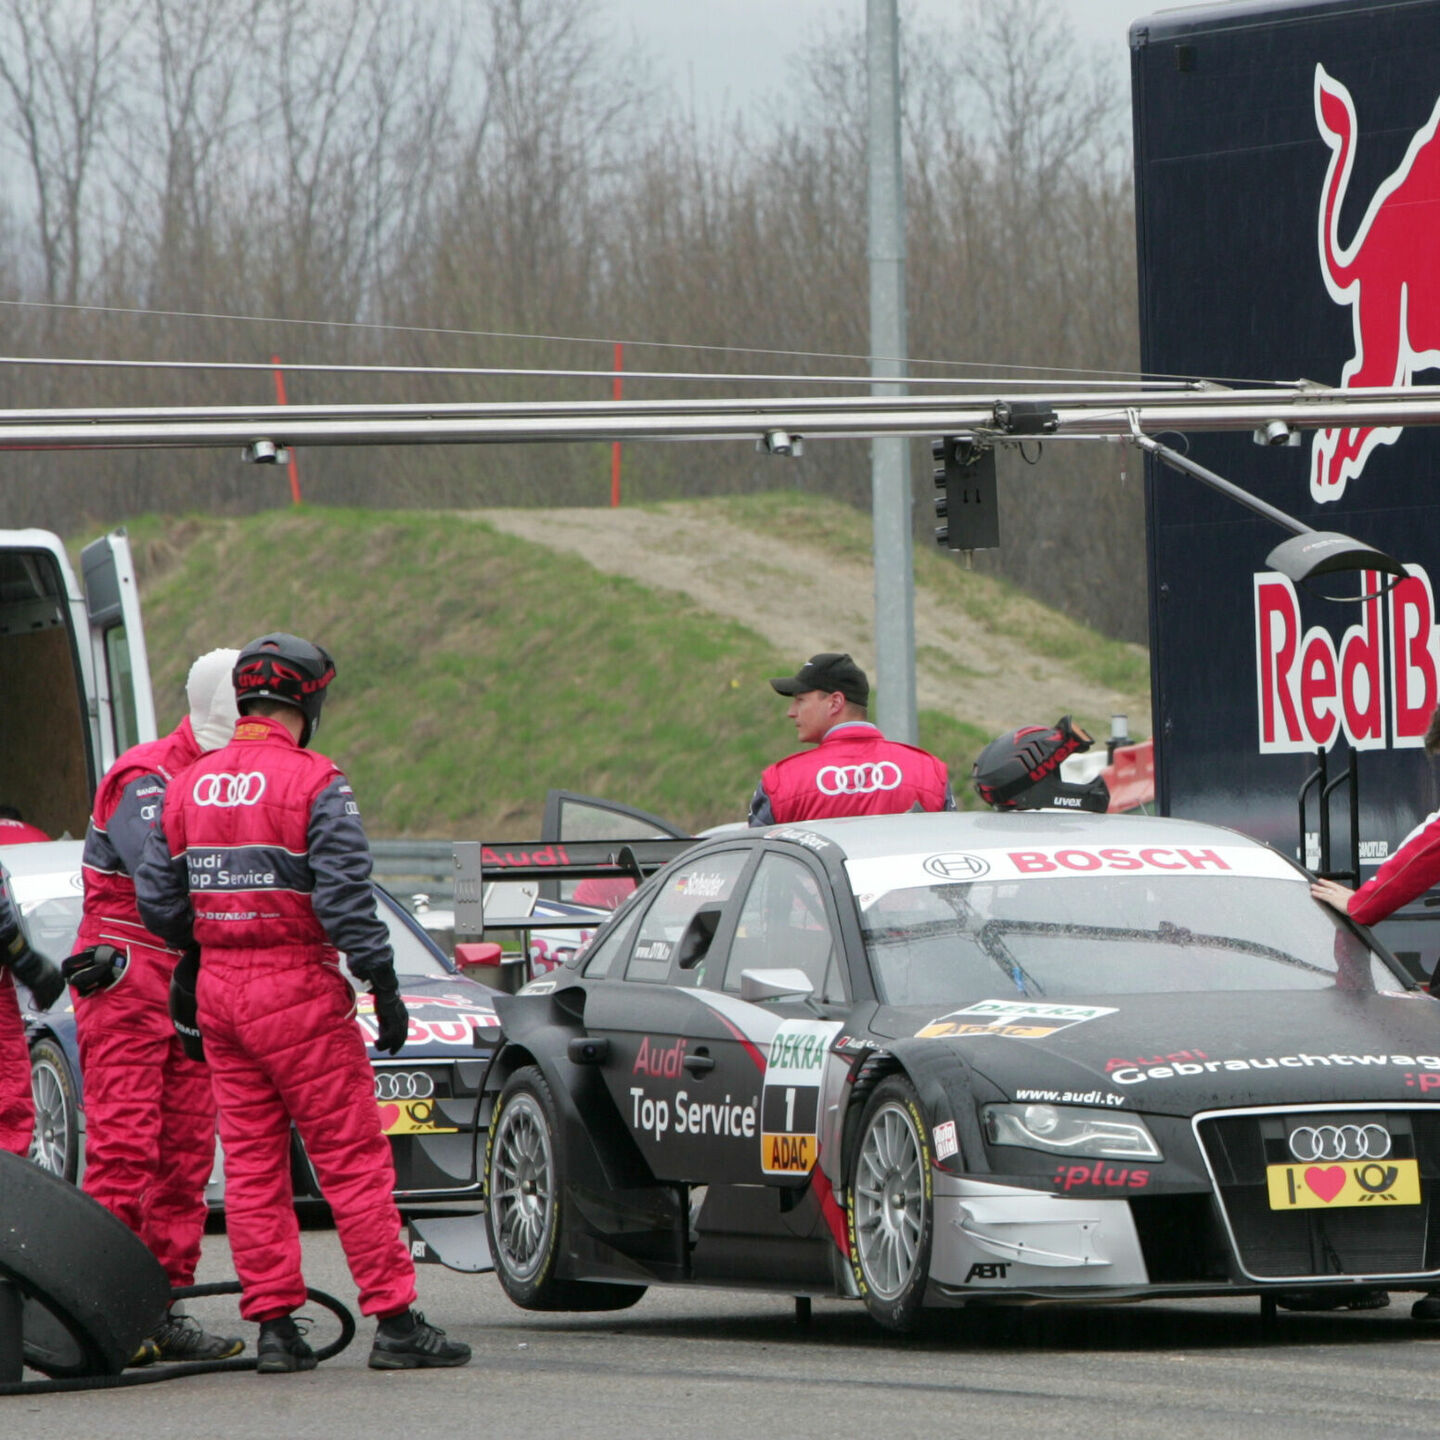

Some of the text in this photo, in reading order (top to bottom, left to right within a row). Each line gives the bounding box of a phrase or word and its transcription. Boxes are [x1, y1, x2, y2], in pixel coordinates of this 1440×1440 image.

[1256, 568, 1385, 748] Red
[1029, 738, 1081, 782] uvex
[1053, 796, 1082, 807] uvex
[482, 845, 571, 867] Audi
[1007, 848, 1232, 874] BOSCH
[189, 870, 275, 888] op Service
[206, 911, 257, 921] DUNLOP
[970, 1004, 1096, 1018] DEKRA
[632, 1036, 687, 1078] Audi
[768, 1034, 828, 1069] DEKRA
[1104, 1048, 1209, 1072] Audi
[785, 1087, 797, 1132] 1
[1016, 1088, 1125, 1106] www.audi.tv
[630, 1087, 756, 1141] Top Service
[771, 1137, 808, 1171] ADAC
[1053, 1160, 1150, 1191] :plus
[964, 1262, 1013, 1283] ABT
